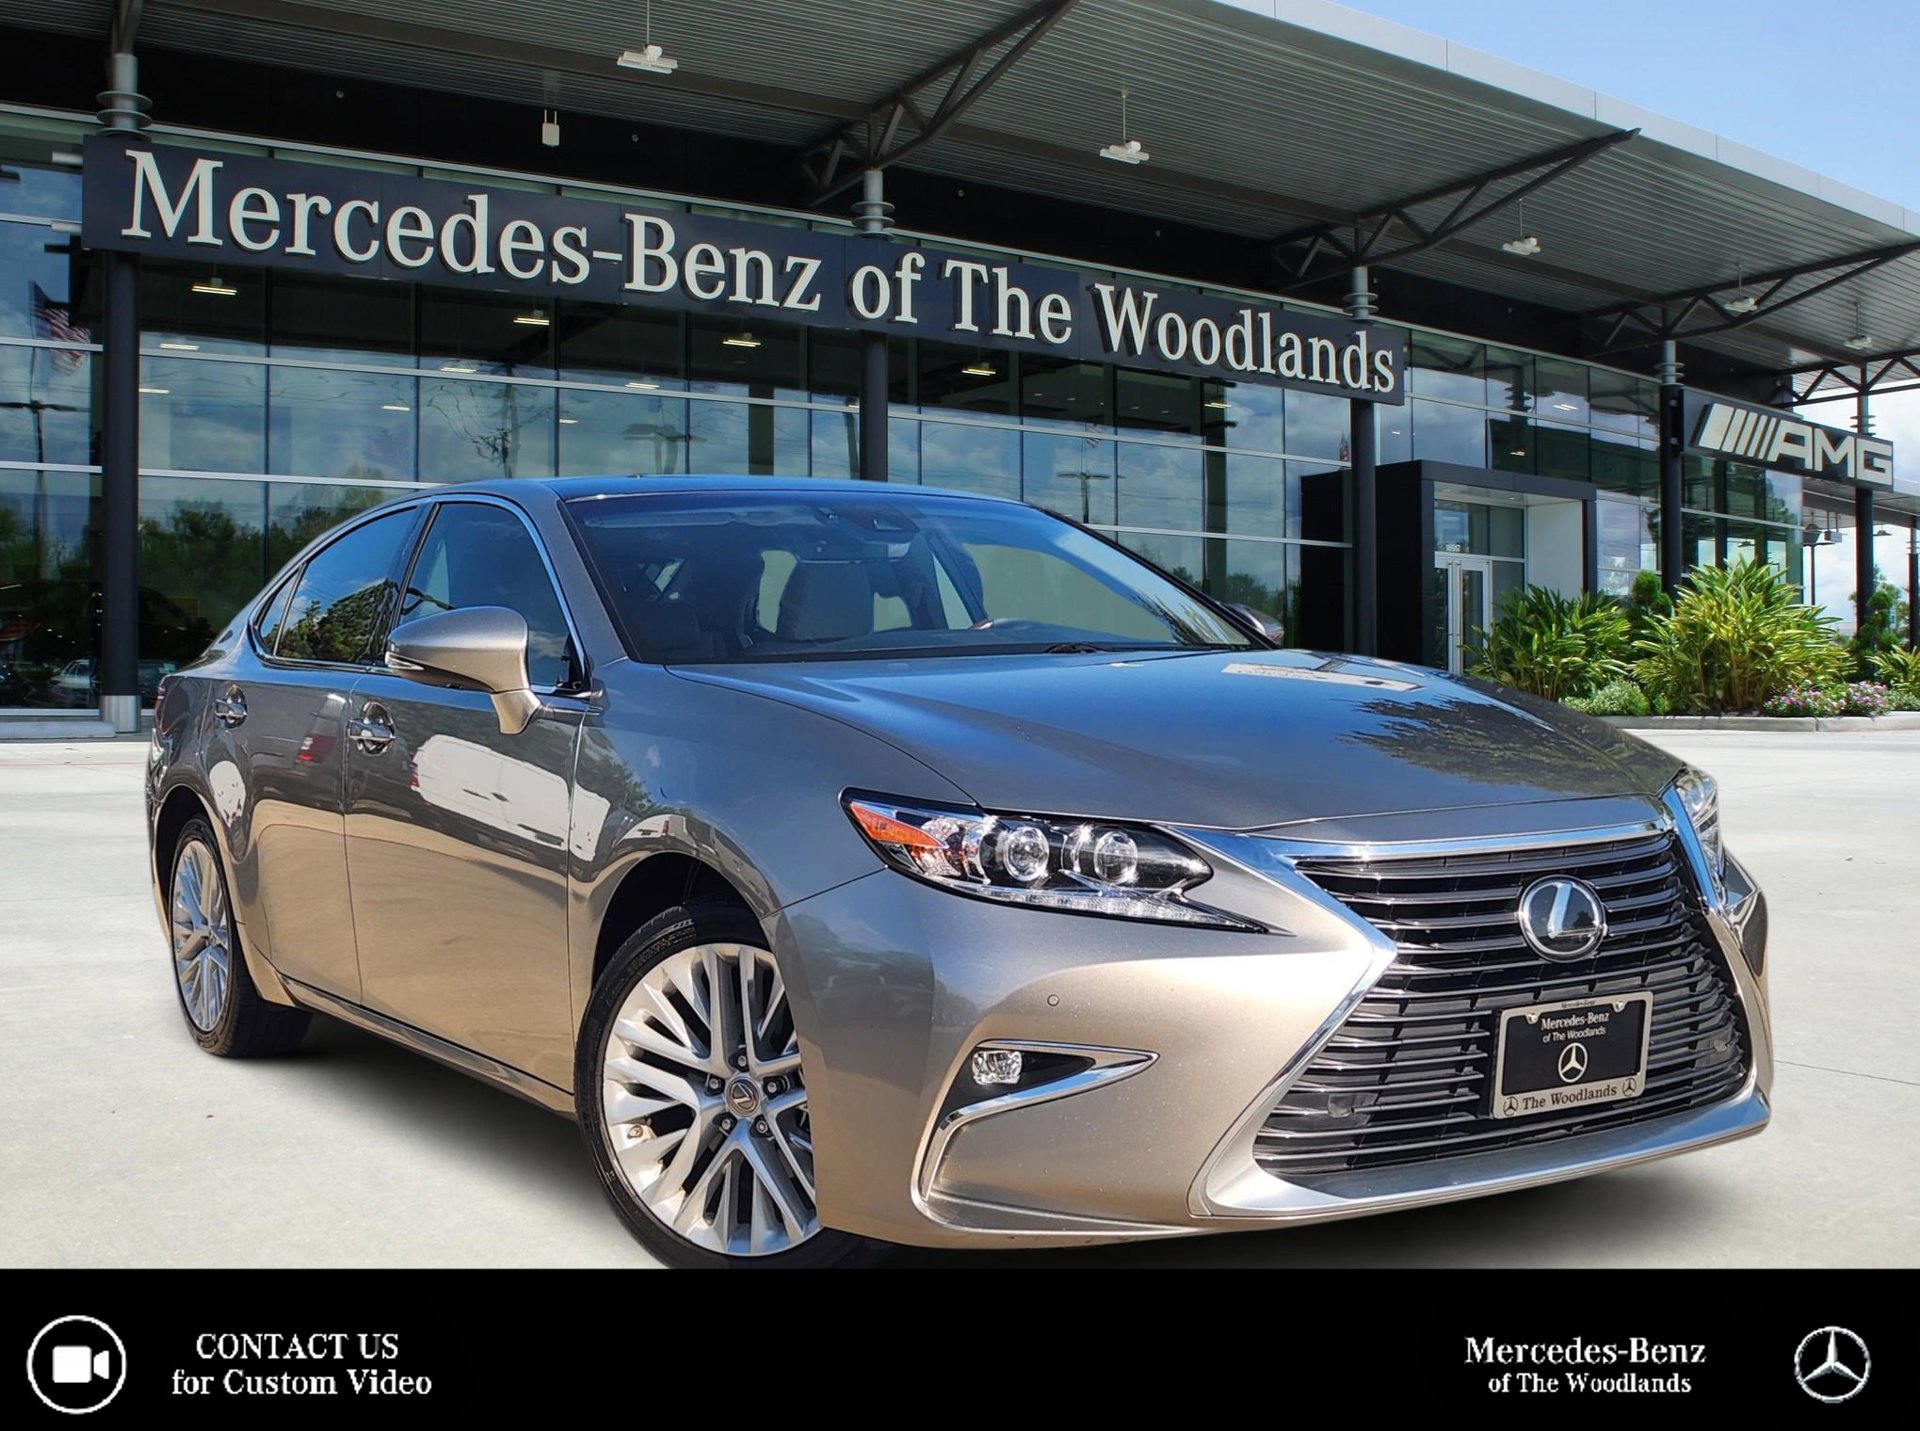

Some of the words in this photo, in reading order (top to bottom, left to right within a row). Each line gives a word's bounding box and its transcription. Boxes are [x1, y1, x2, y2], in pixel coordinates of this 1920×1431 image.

[121, 148, 823, 312] Mercedes-Benz
[851, 252, 925, 324] of
[943, 259, 1073, 344] The
[1094, 283, 1396, 394] Woodlands
[1766, 419, 1893, 486] AMG
[1540, 1011, 1610, 1031] Mercedes-Benz
[1541, 1032, 1551, 1043] of
[1552, 1031, 1566, 1042] The
[1567, 1025, 1607, 1040] Woodlands
[1522, 1096, 1546, 1111] The
[1551, 1084, 1618, 1106] Woodlands
